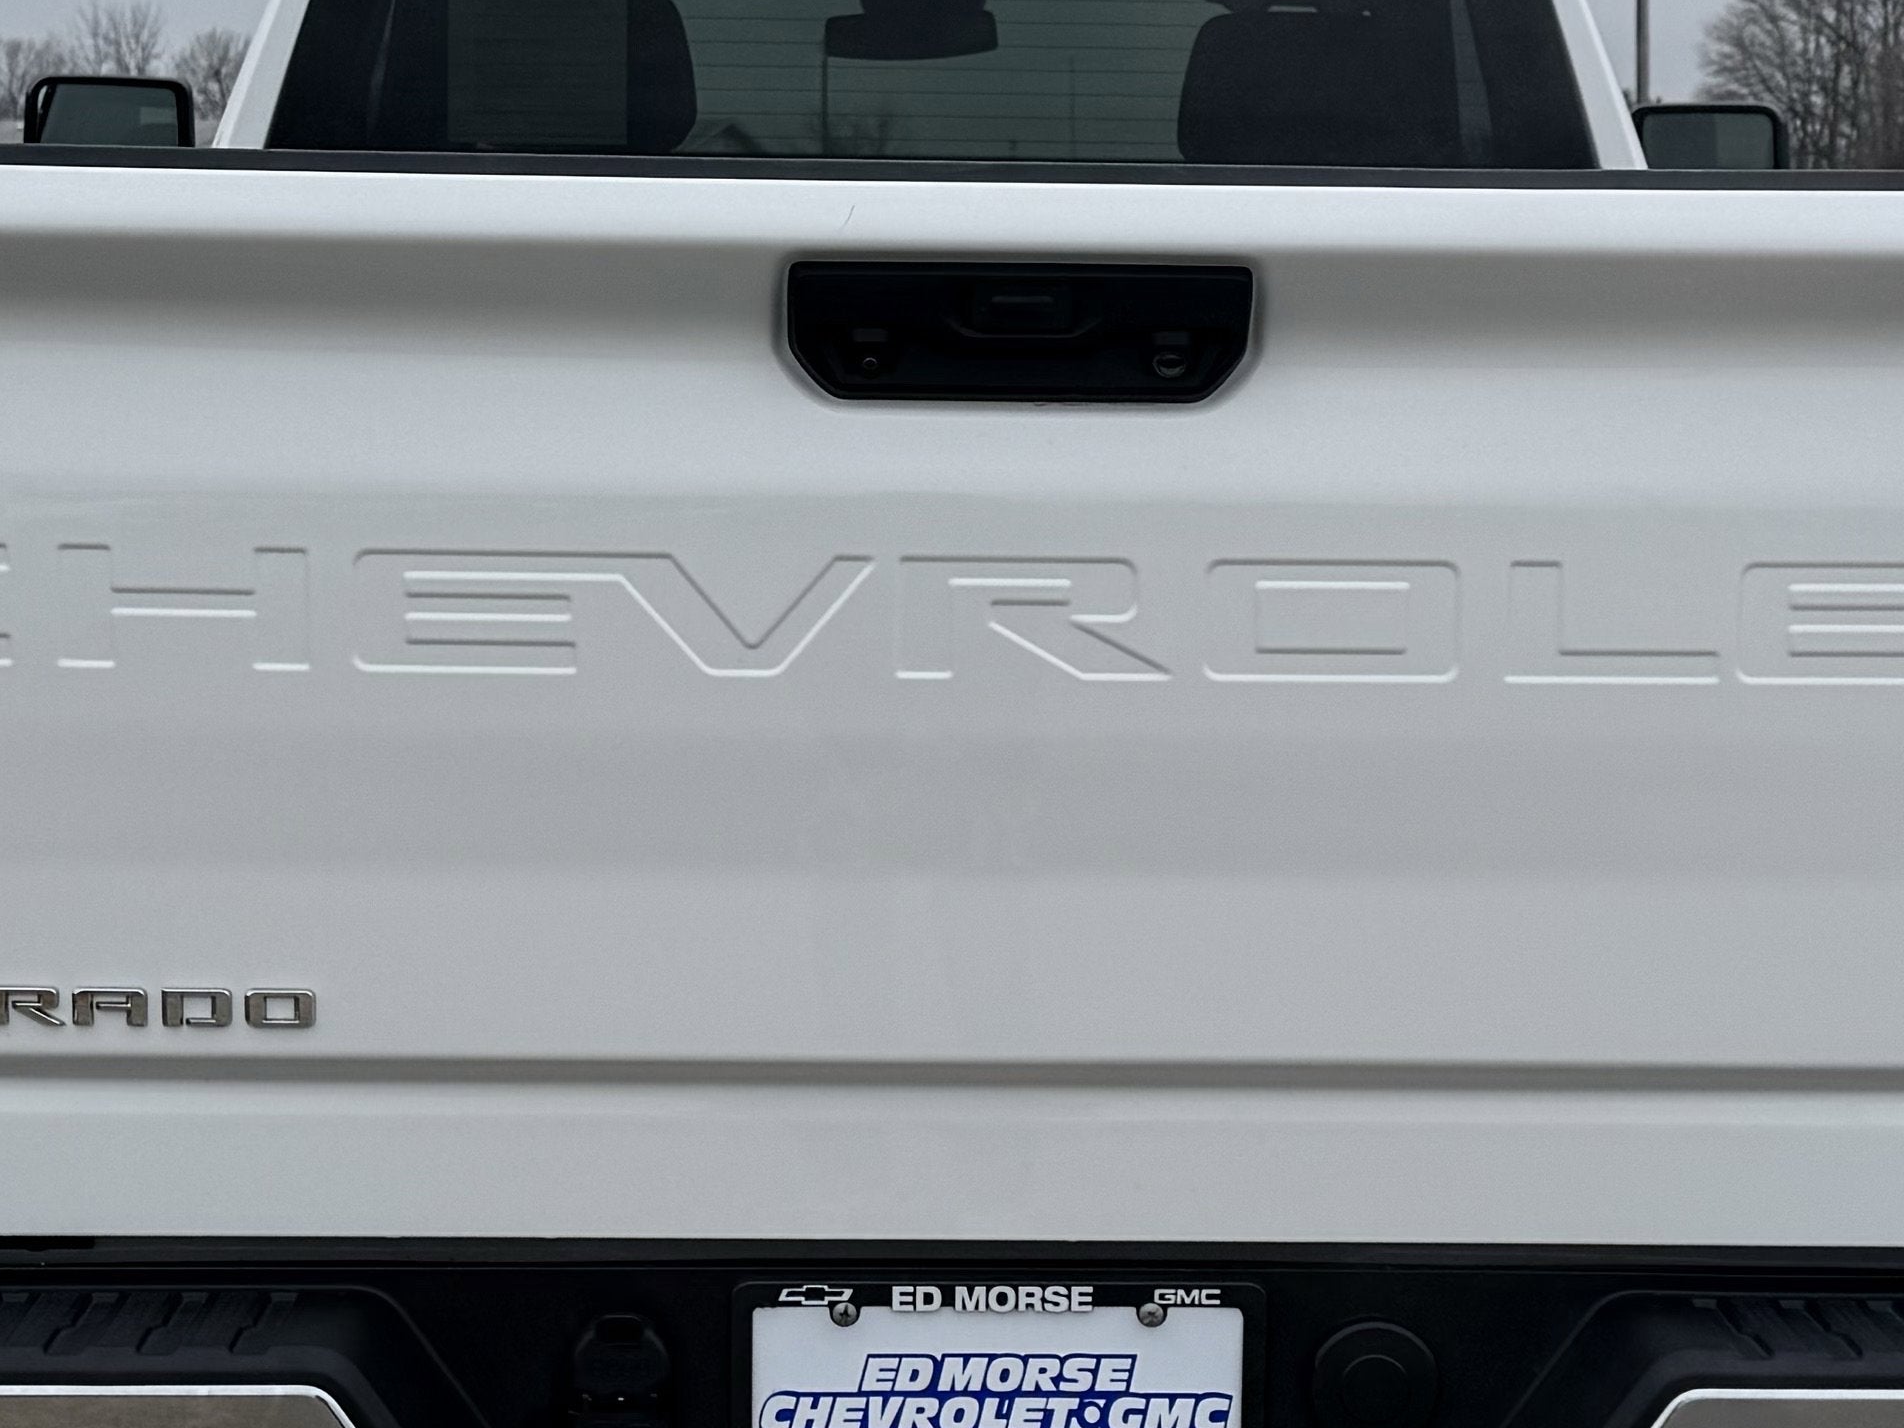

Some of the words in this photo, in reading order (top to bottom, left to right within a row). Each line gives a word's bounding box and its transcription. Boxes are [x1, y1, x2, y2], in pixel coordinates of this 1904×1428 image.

[891, 1286, 943, 1312] ED
[955, 1286, 1094, 1312] MORSE
[1153, 1289, 1221, 1305] GMC
[861, 1356, 935, 1392] ED
[937, 1356, 1135, 1392] MORSE
